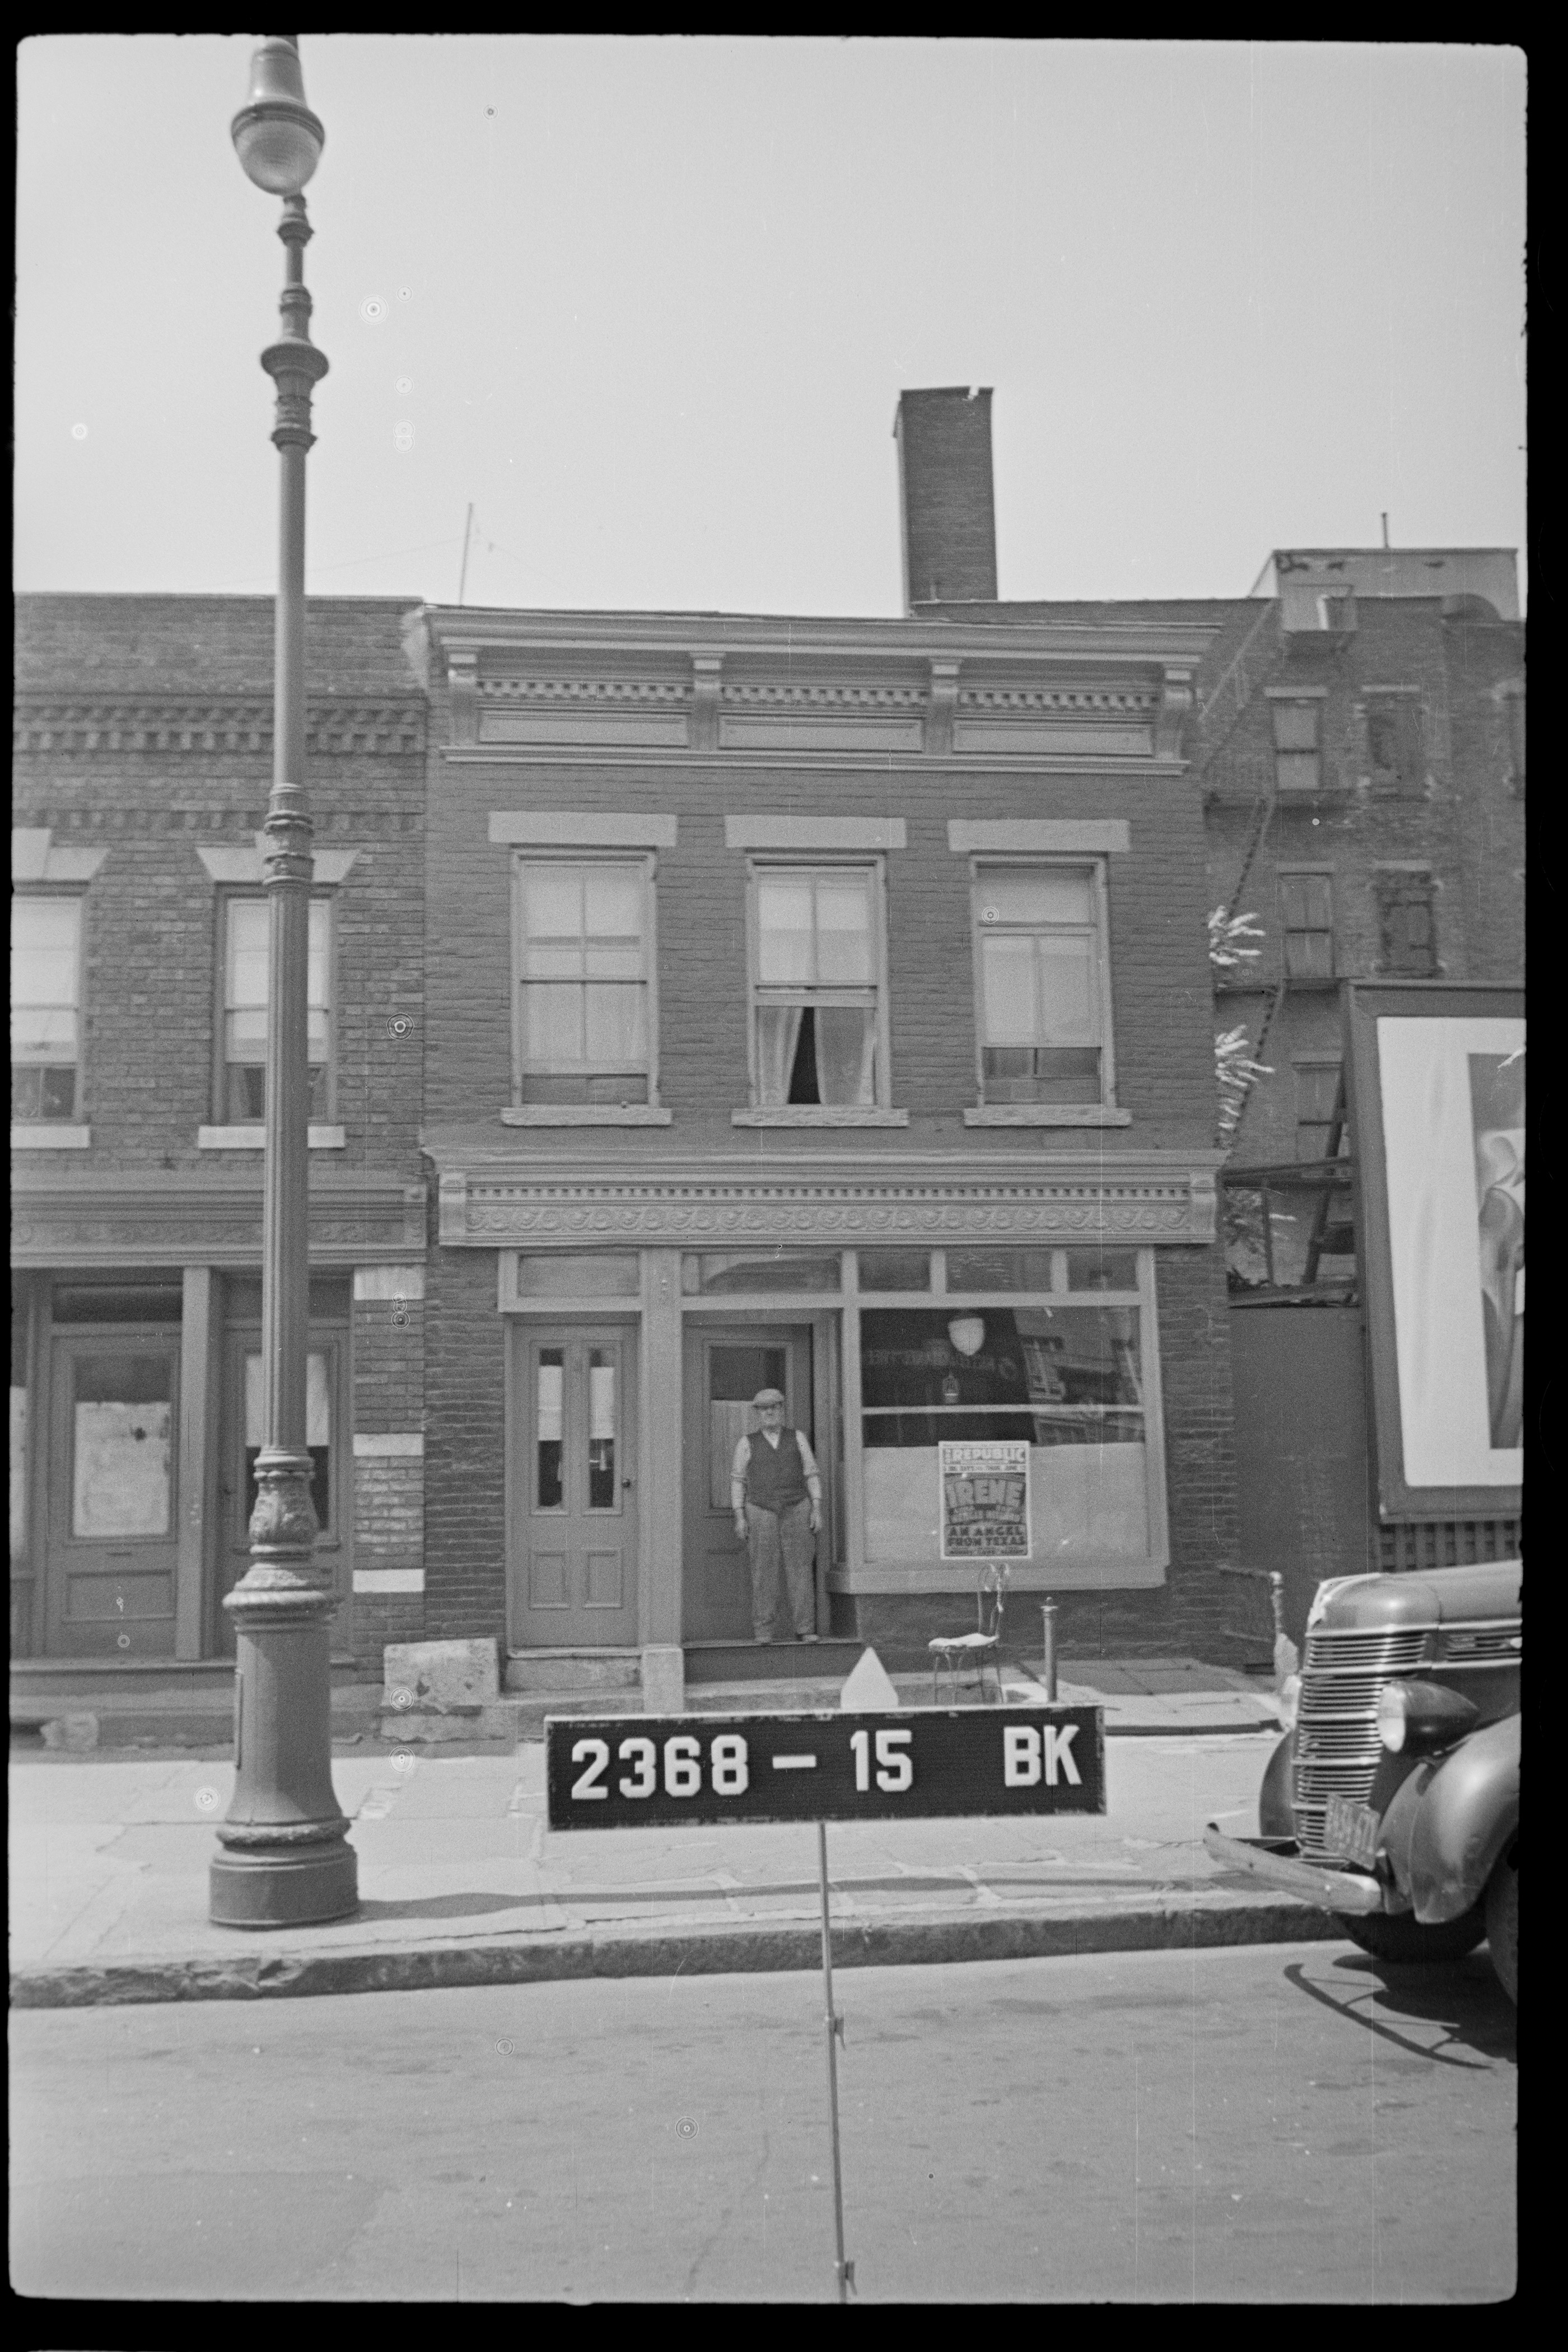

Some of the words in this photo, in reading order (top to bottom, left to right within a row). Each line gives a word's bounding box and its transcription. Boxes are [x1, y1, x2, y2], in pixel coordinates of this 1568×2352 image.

[952, 1448, 1026, 1462] REPUBLIC
[945, 1479, 1024, 1508] IRENE
[974, 1525, 1024, 1536] ANGEL
[947, 1537, 982, 1546] FROM
[985, 1536, 1026, 1546] TEXAS
[572, 1735, 748, 1799] 2368
[851, 1730, 912, 1791] 15
[1004, 1725, 1081, 1786] BK
